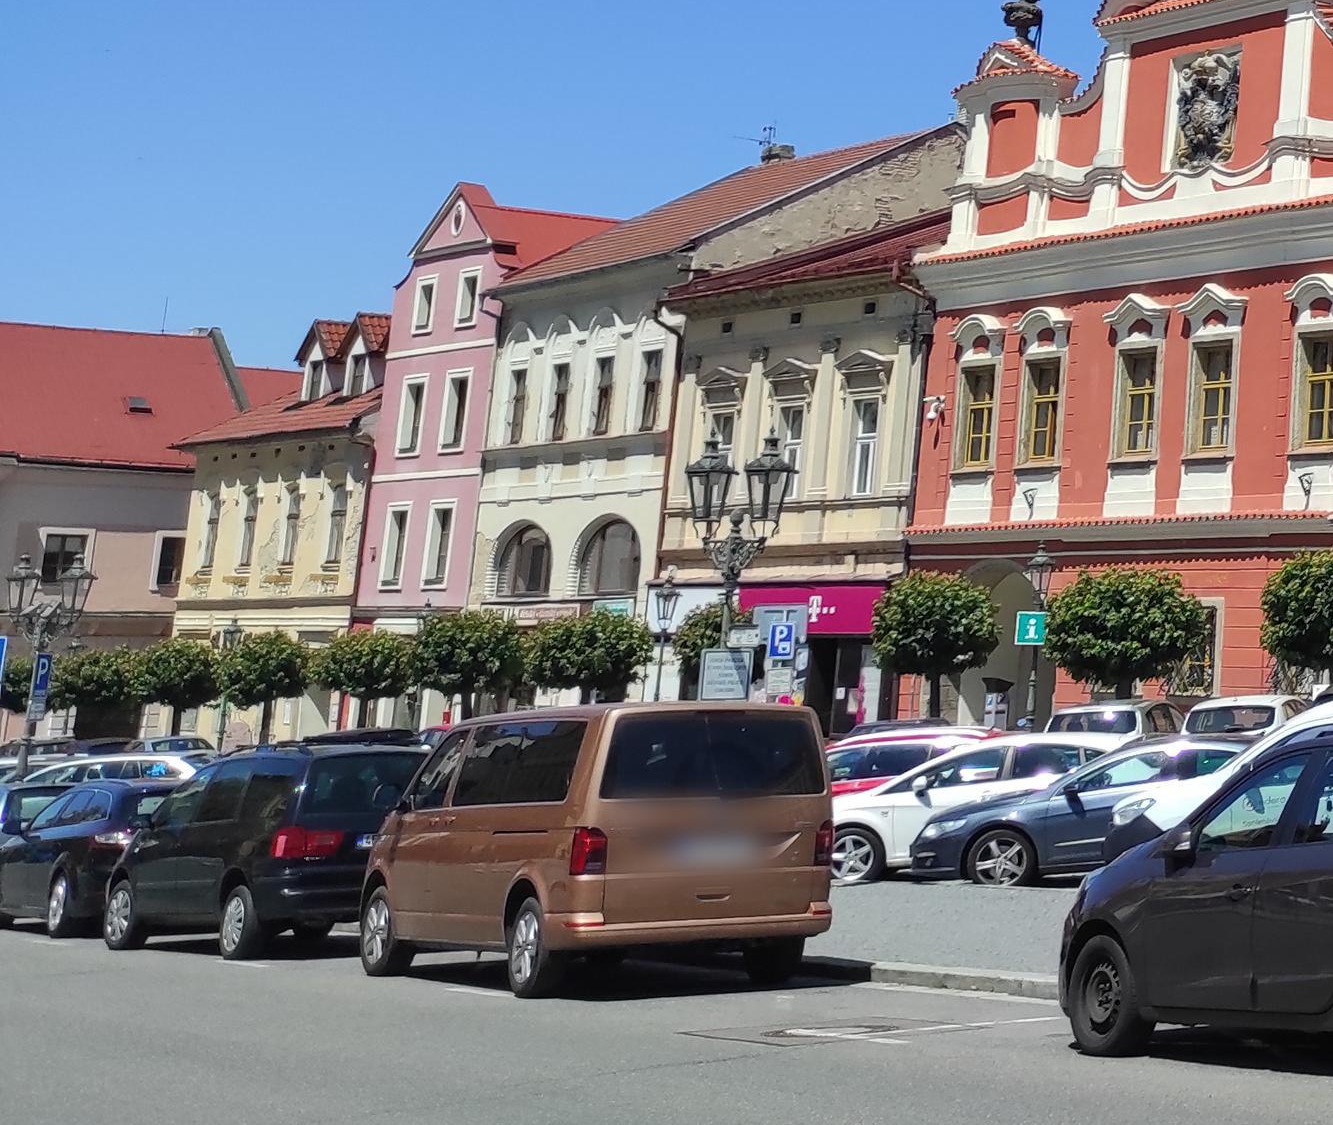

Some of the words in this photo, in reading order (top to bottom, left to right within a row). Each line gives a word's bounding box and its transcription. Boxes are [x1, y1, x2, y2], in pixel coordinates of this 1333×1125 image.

[808, 596, 822, 623] T
[774, 626, 788, 646] P
[37, 659, 48, 685] P
